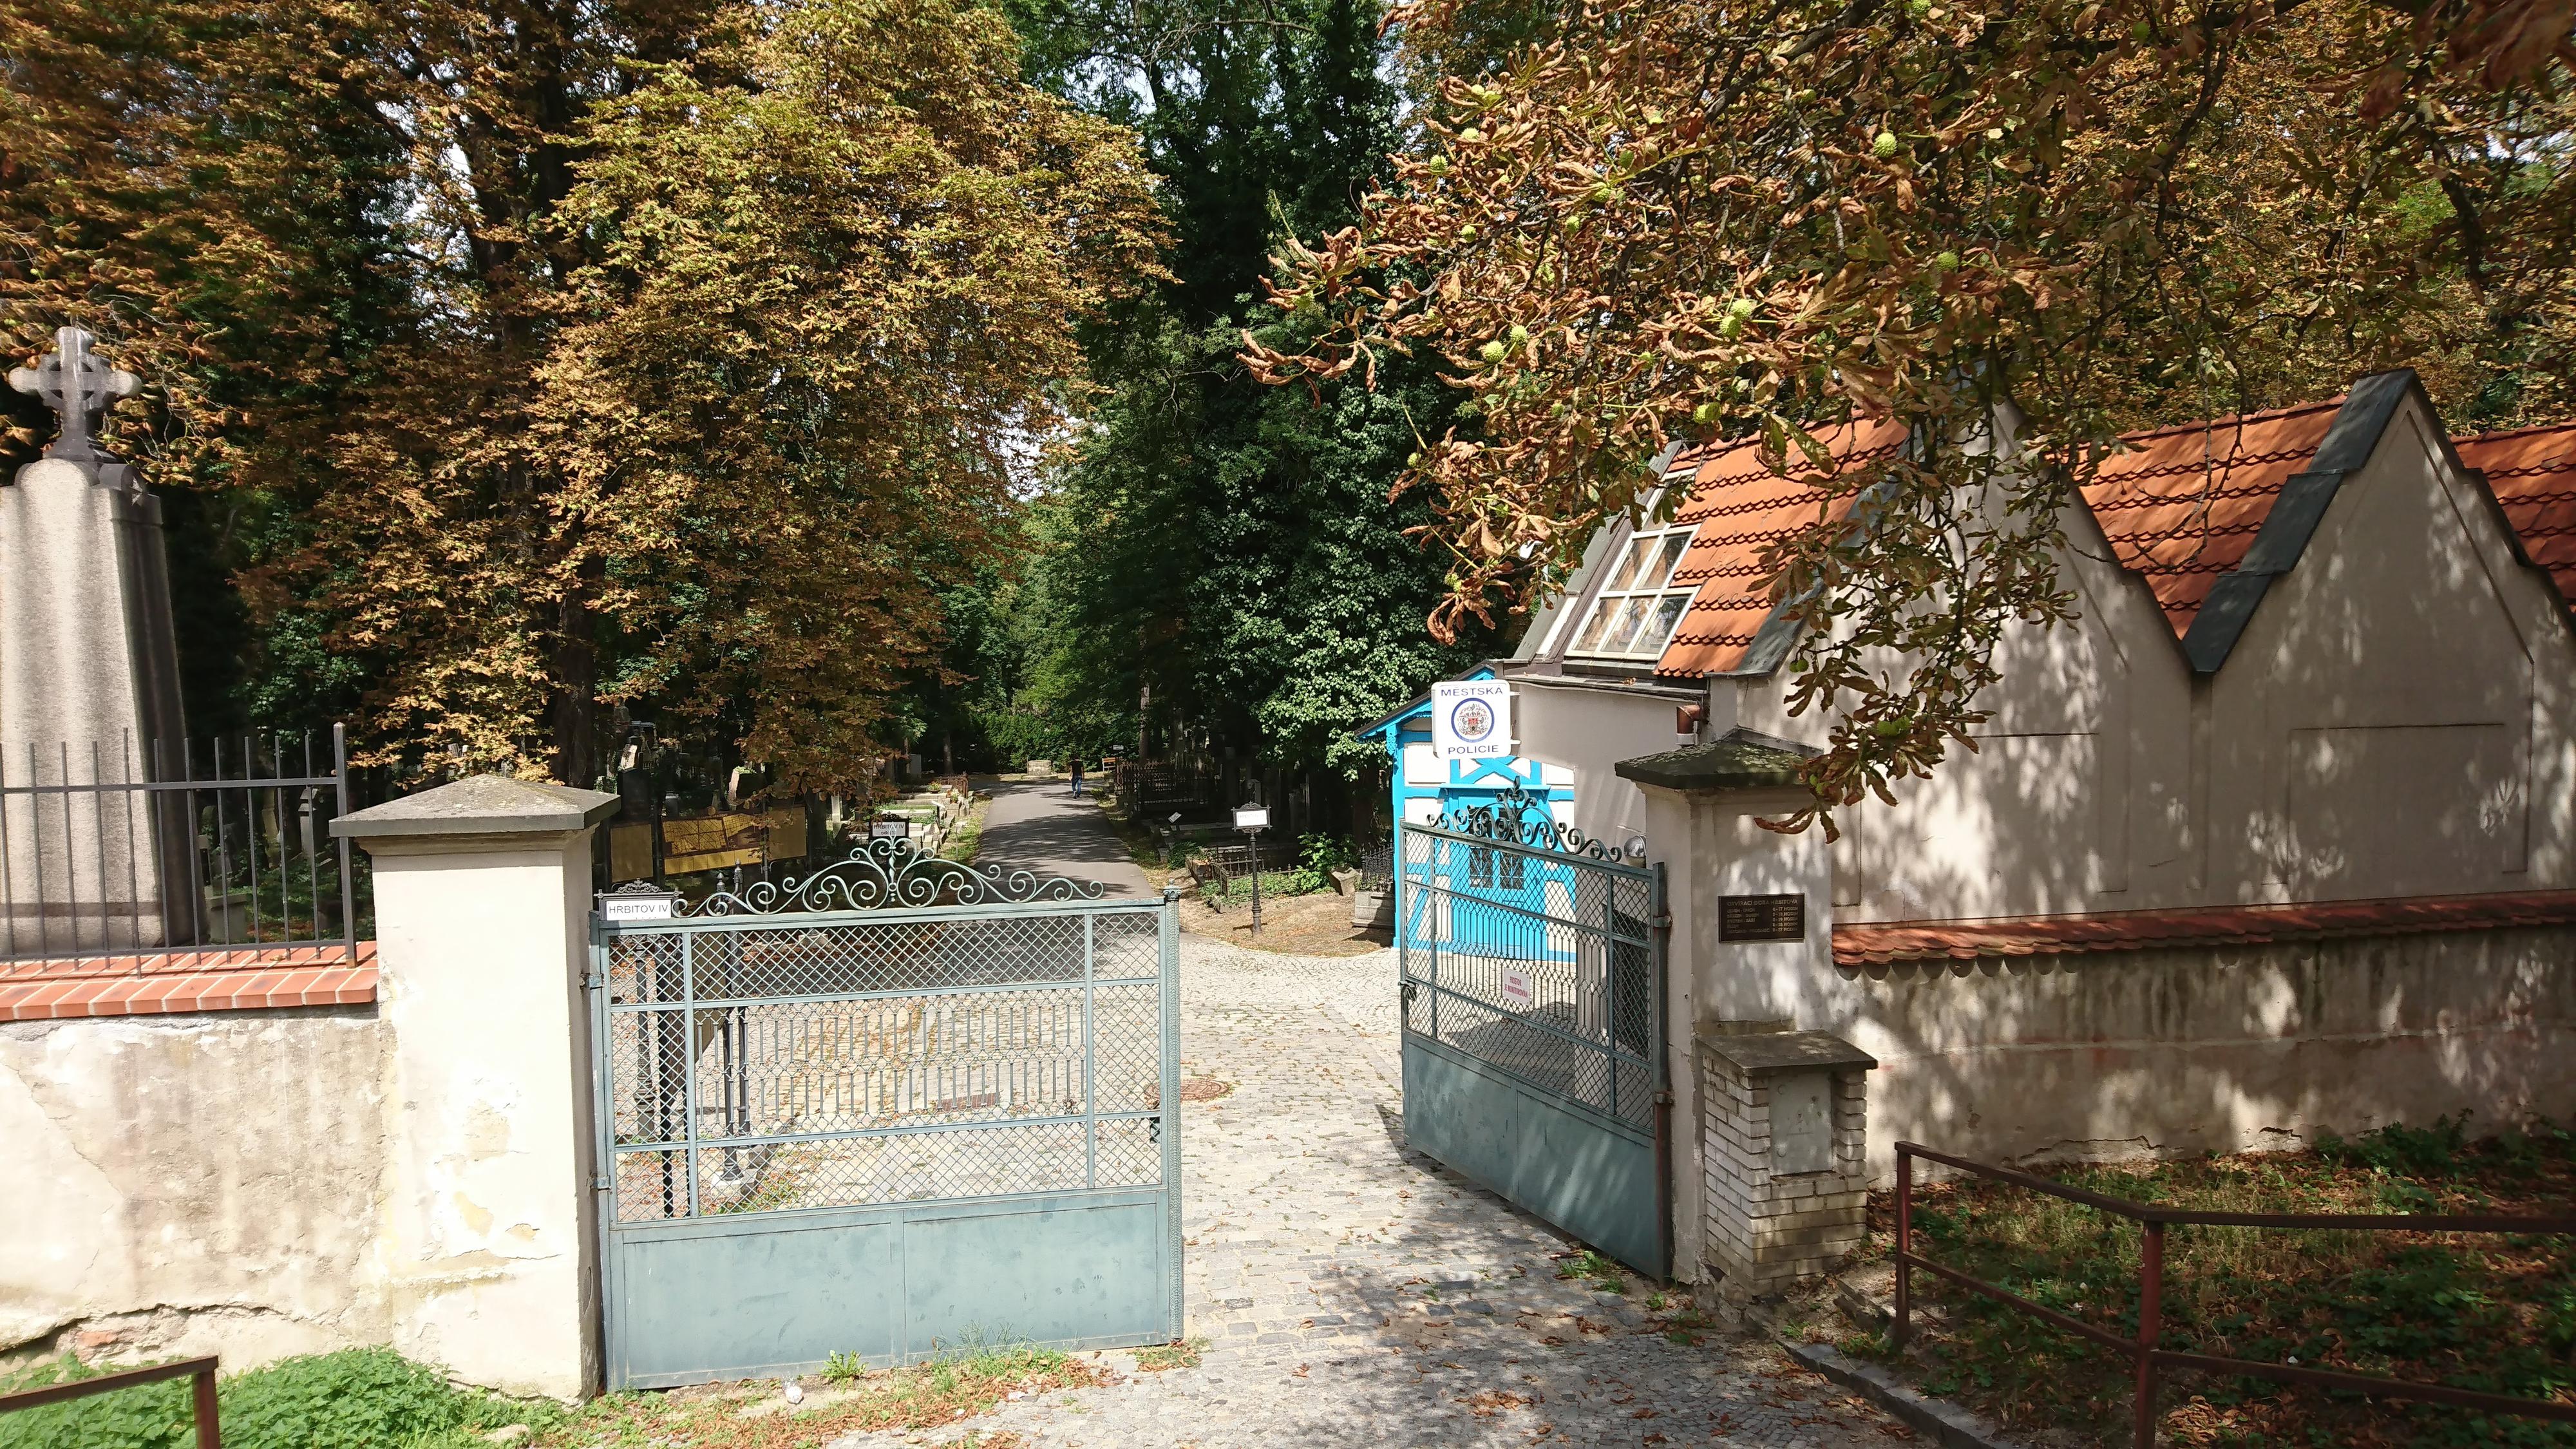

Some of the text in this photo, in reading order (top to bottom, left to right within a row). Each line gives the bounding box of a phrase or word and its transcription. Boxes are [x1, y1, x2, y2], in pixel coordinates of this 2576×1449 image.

[1441, 685, 1503, 696] MĚSTSKÁ
[1448, 744, 1499, 754] POLICIE
[609, 904, 668, 914] HŘBITOV IV
[1510, 976, 1522, 986] PROSTOR
